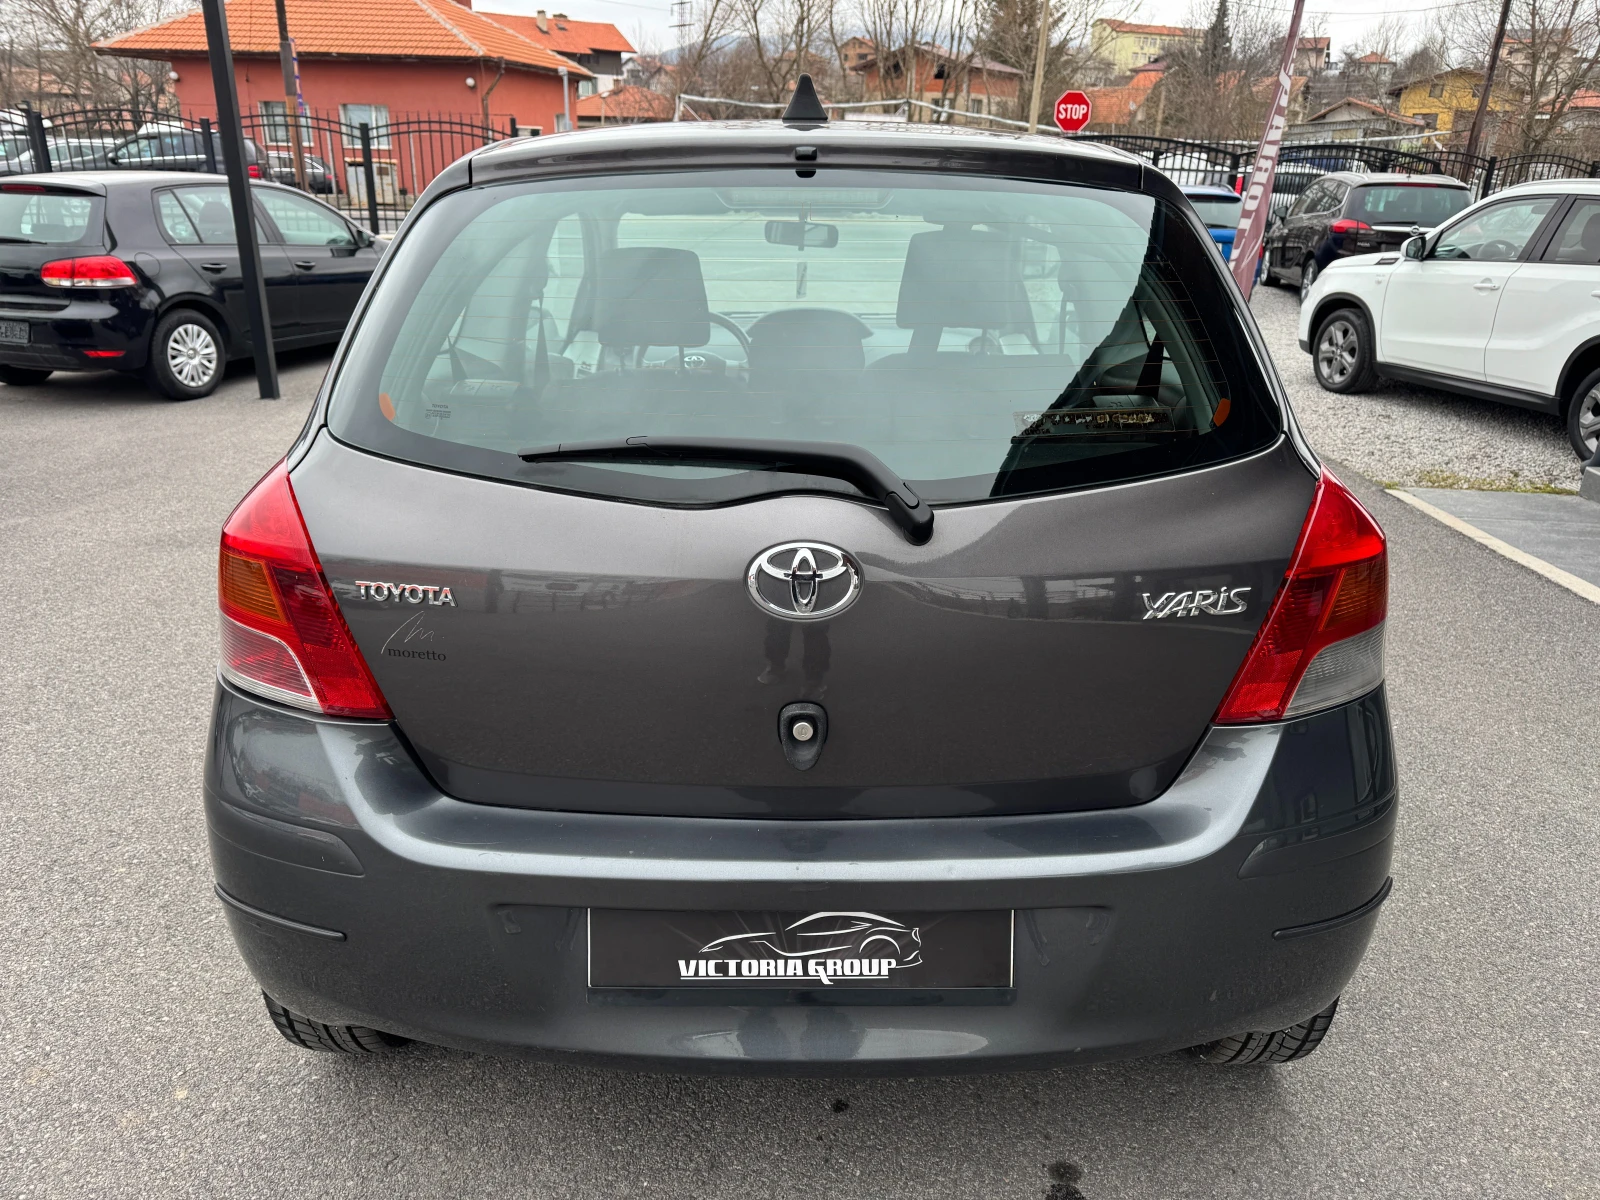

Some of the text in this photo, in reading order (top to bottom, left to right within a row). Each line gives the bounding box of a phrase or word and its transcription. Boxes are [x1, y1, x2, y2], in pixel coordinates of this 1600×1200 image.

[1058, 104, 1087, 119] STOP
[355, 580, 456, 607] TOYOTA
[387, 647, 447, 662] moretto
[678, 958, 897, 984] VICTORIA GROUP
